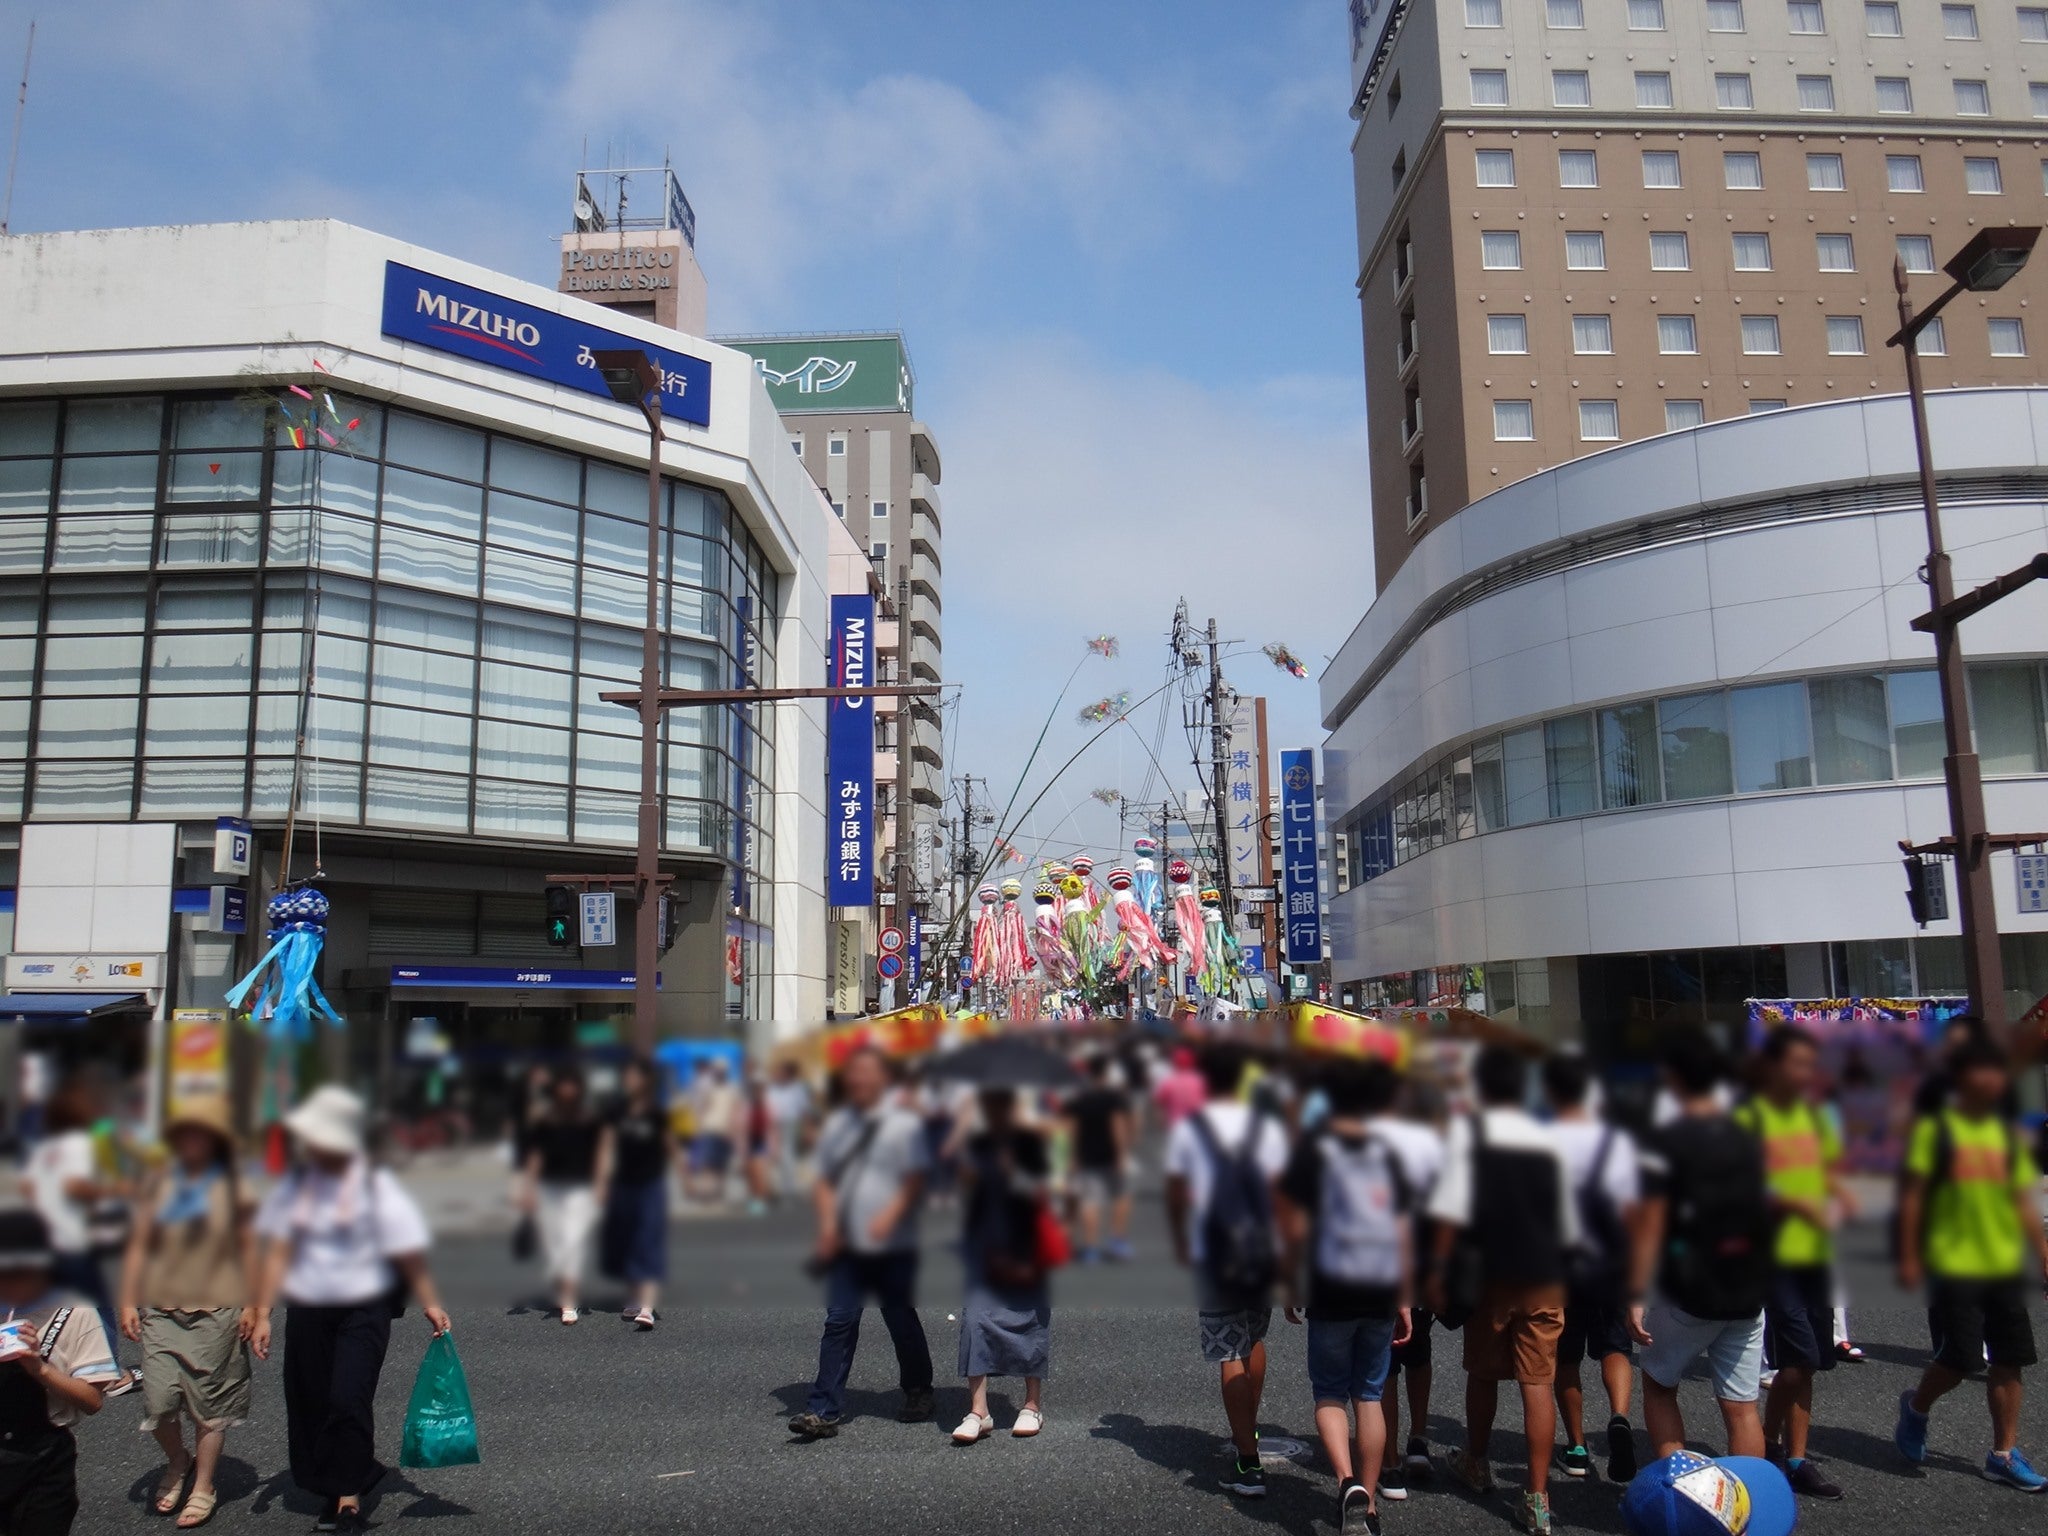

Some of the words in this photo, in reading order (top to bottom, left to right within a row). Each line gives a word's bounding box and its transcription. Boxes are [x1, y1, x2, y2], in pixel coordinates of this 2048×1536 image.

[566, 247, 673, 271] Pacifico
[566, 274, 616, 292] Hotel
[619, 274, 633, 291] &
[638, 273, 671, 291] Spa
[416, 288, 541, 348] MIZUHO
[845, 617, 865, 709] MIZUHO
[235, 839, 245, 858] P
[840, 780, 861, 882] みずほ銀行
[1286, 799, 1317, 947] 七十七銀行
[840, 924, 851, 970] Fresh
[884, 935, 899, 947] 40
